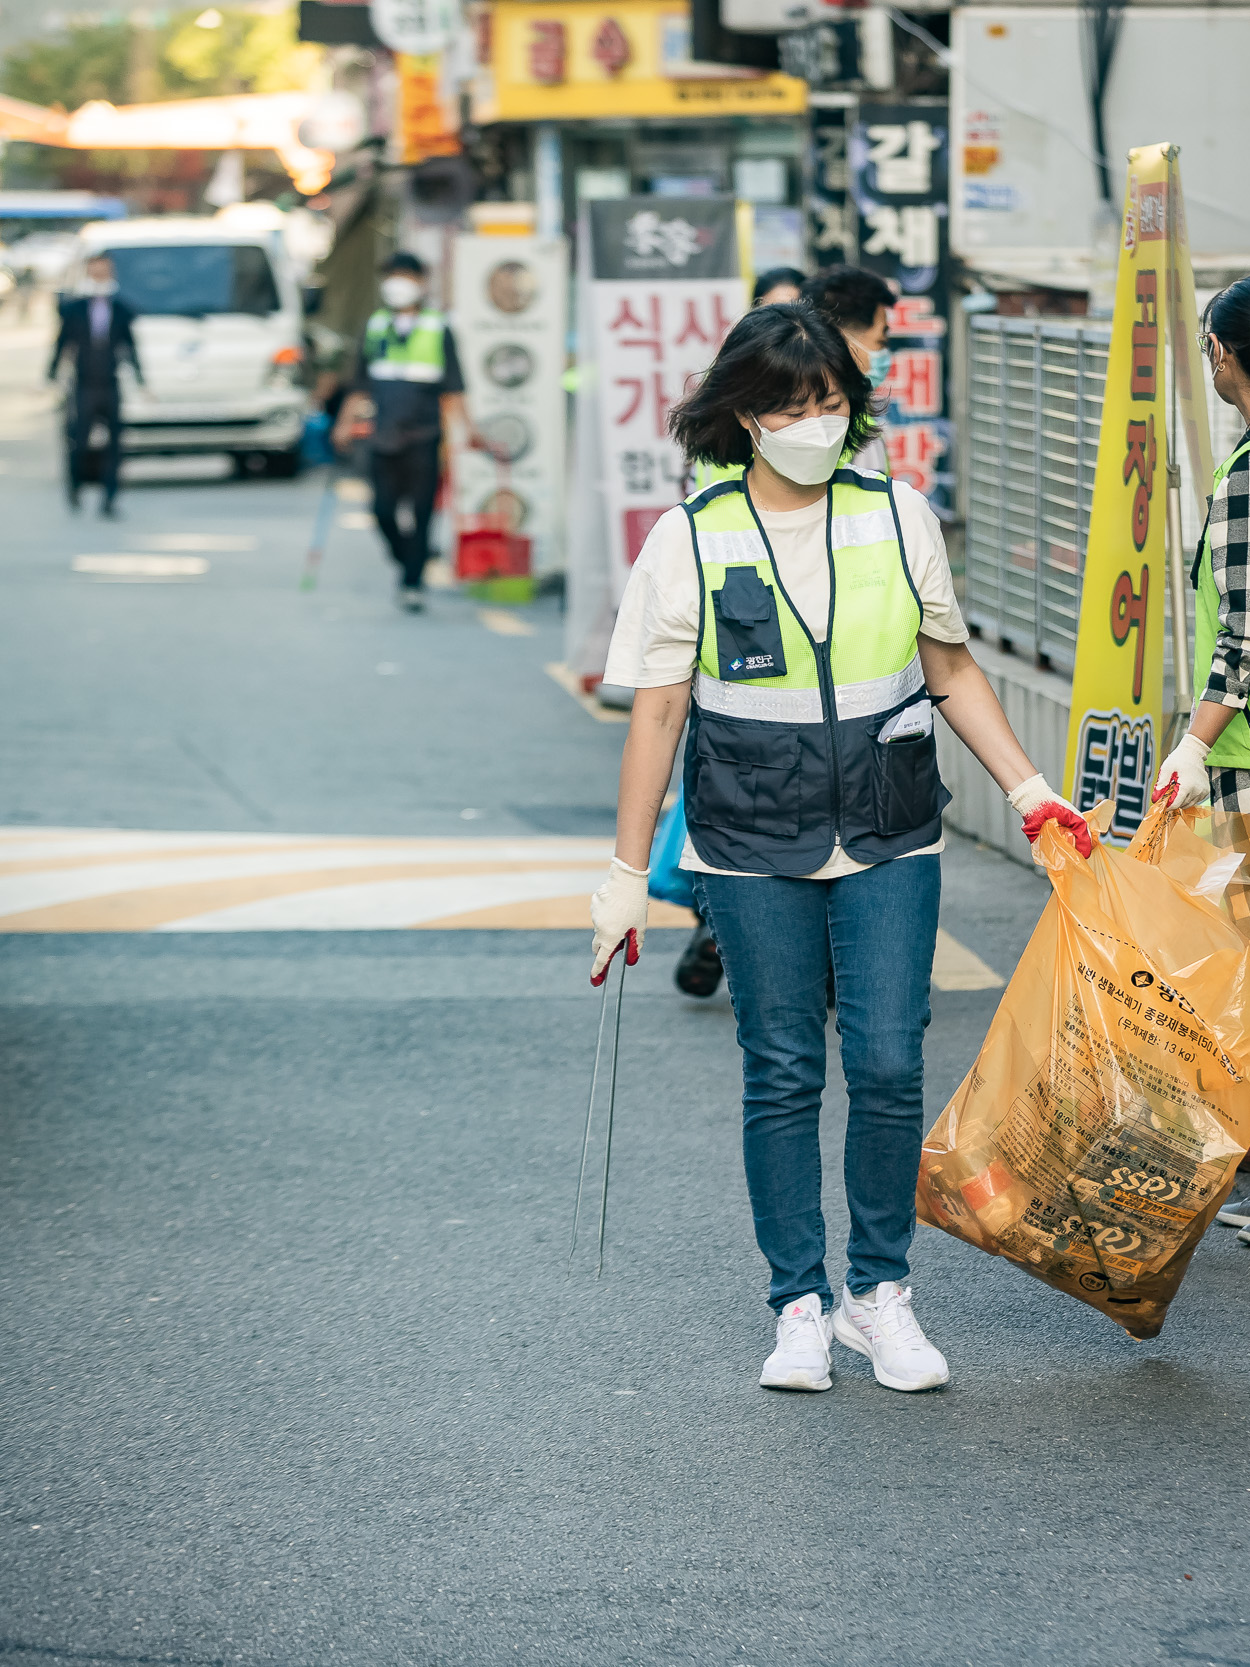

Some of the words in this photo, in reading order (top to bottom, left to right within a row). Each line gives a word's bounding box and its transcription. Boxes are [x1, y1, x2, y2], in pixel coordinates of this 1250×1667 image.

[1112, 268, 1159, 704] 꼼장어
[1095, 975, 1143, 1015] 생활쓰레기
[1163, 1040, 1178, 1054] 13
[1177, 1047, 1197, 1064] kg)
[1051, 1108, 1098, 1145] 19:00~24:00
[1028, 1196, 1097, 1239] 광진구청장
